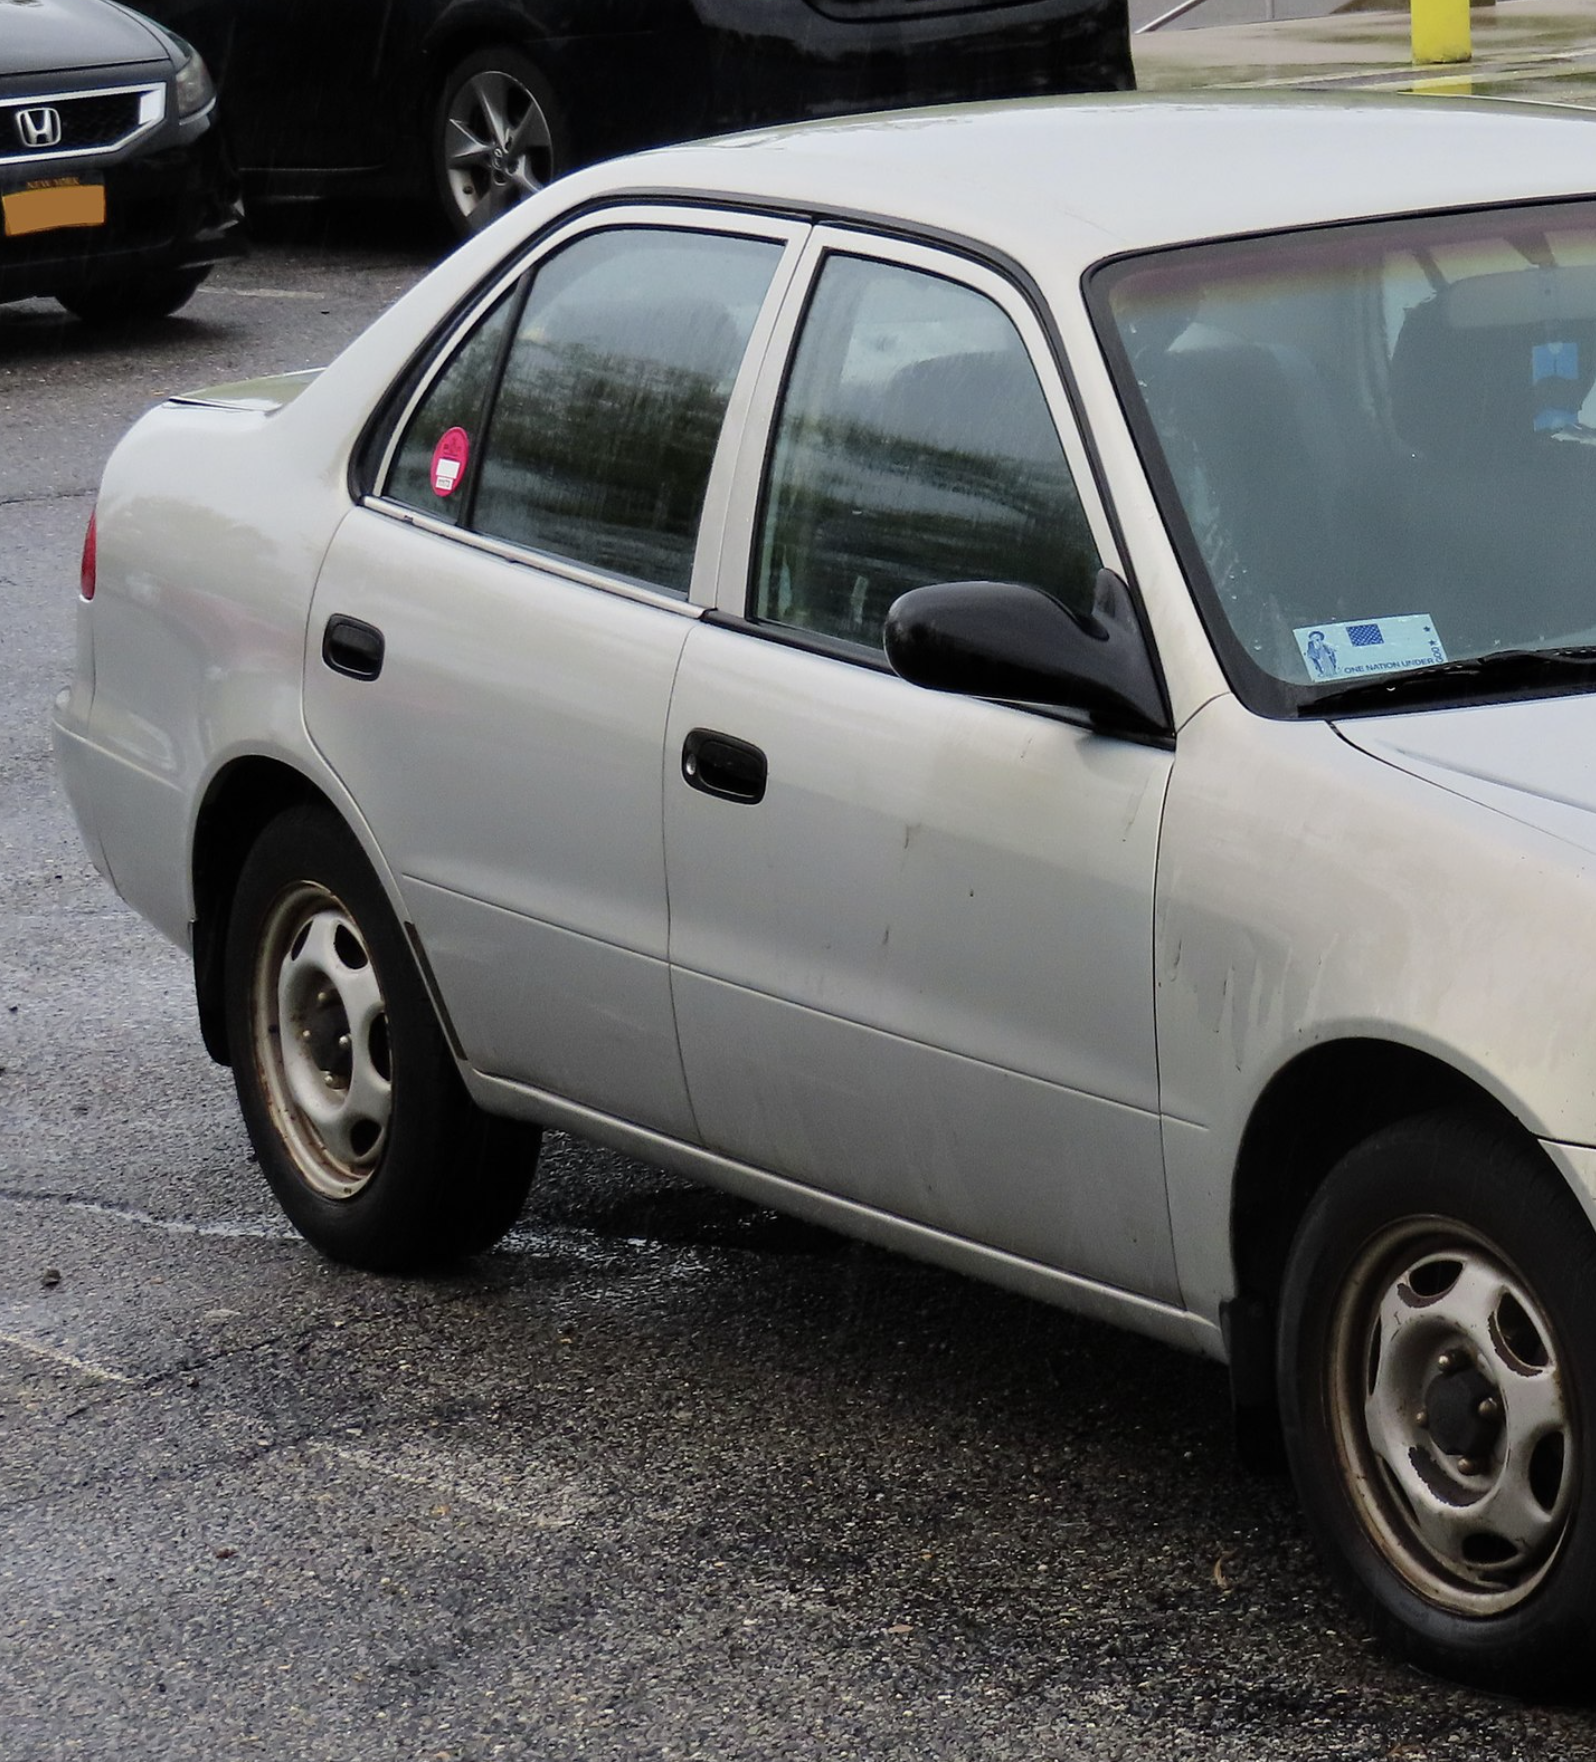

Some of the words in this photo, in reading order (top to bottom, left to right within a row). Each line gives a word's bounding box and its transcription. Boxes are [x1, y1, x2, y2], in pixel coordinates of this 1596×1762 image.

[1344, 666, 1364, 674] ONE
[1366, 661, 1400, 671] NATION
[1401, 657, 1434, 667] UNDER
